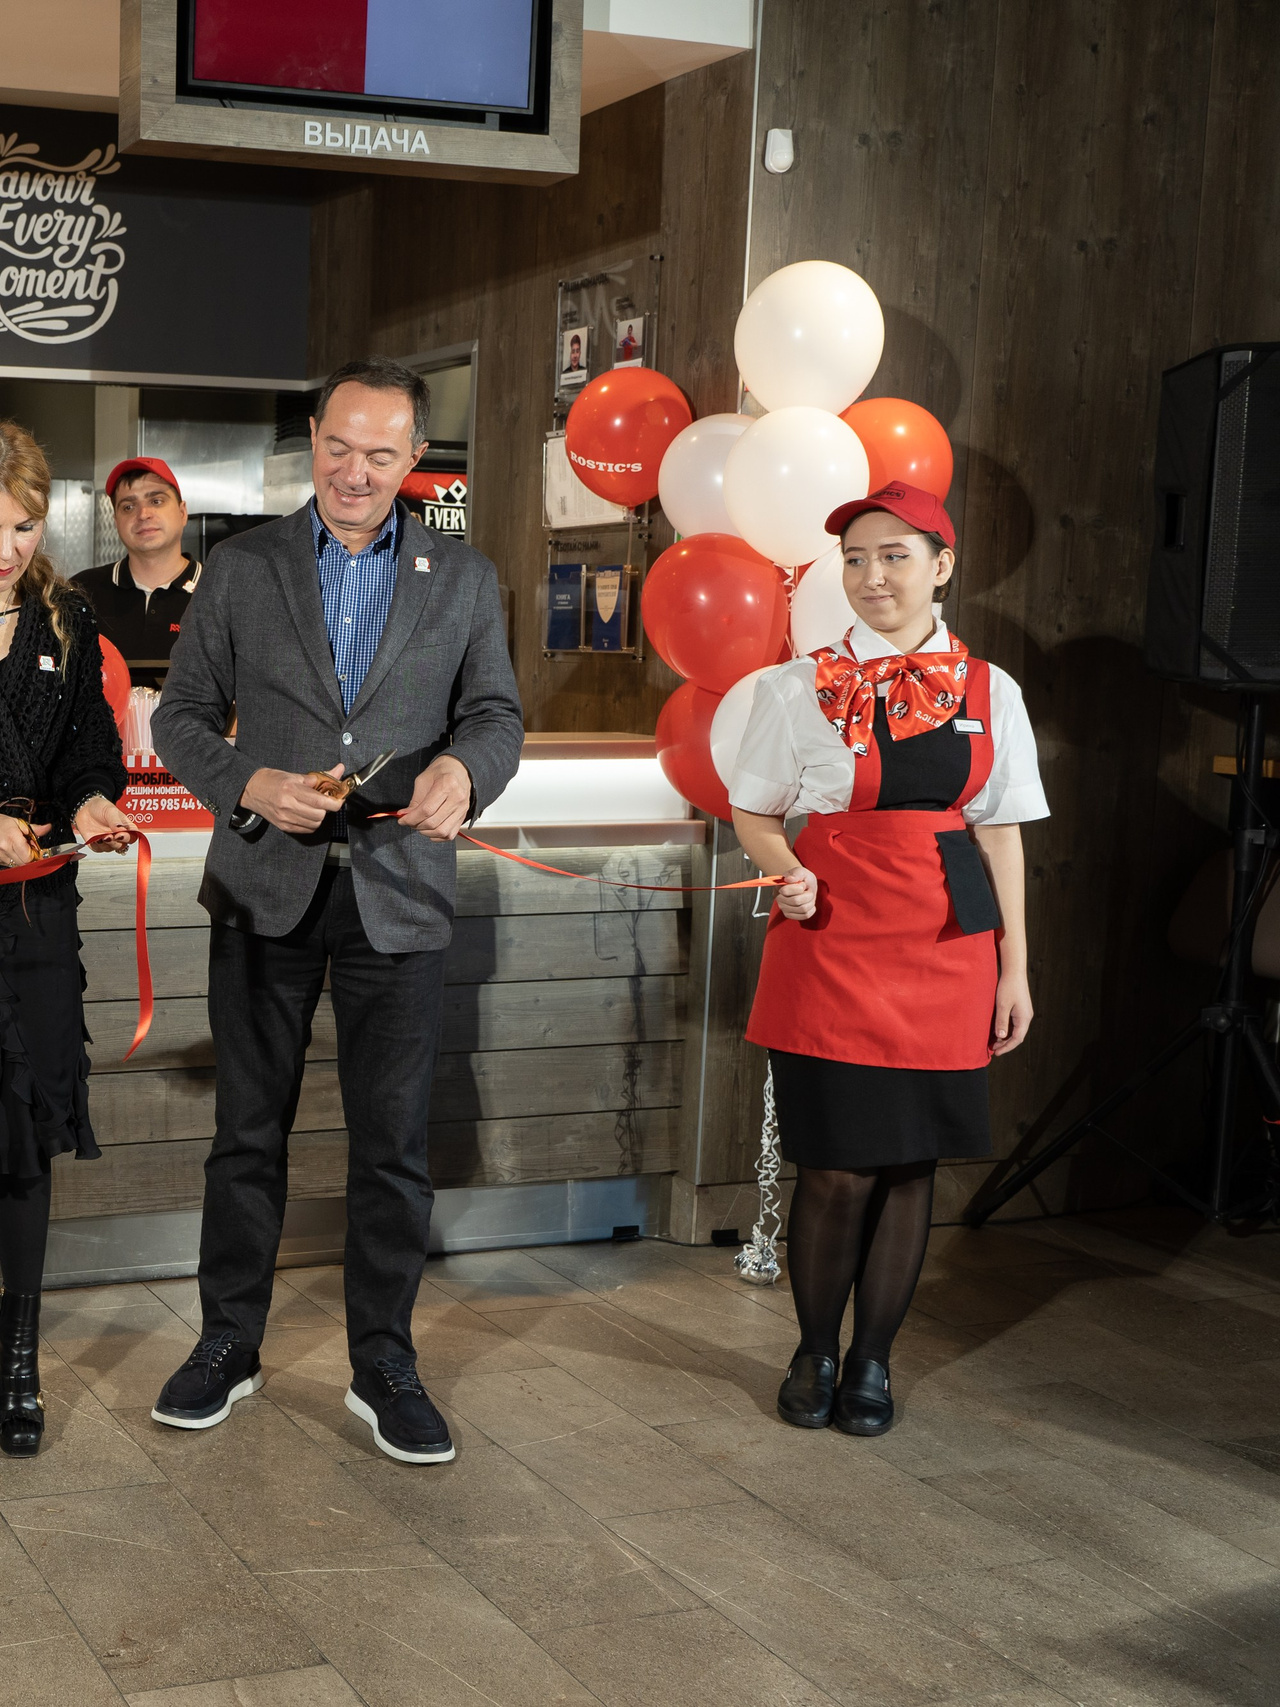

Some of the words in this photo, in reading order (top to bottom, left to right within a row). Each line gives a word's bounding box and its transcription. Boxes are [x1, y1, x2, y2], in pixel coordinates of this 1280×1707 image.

[304, 121, 430, 155] ВЫДАЧА
[570, 450, 643, 473] ROSTIC'S
[126, 787, 154, 795] РЕШИМ
[126, 799, 138, 811] +7
[139, 798, 159, 811] 925
[160, 798, 180, 811] 985
[181, 798, 196, 810] 44
